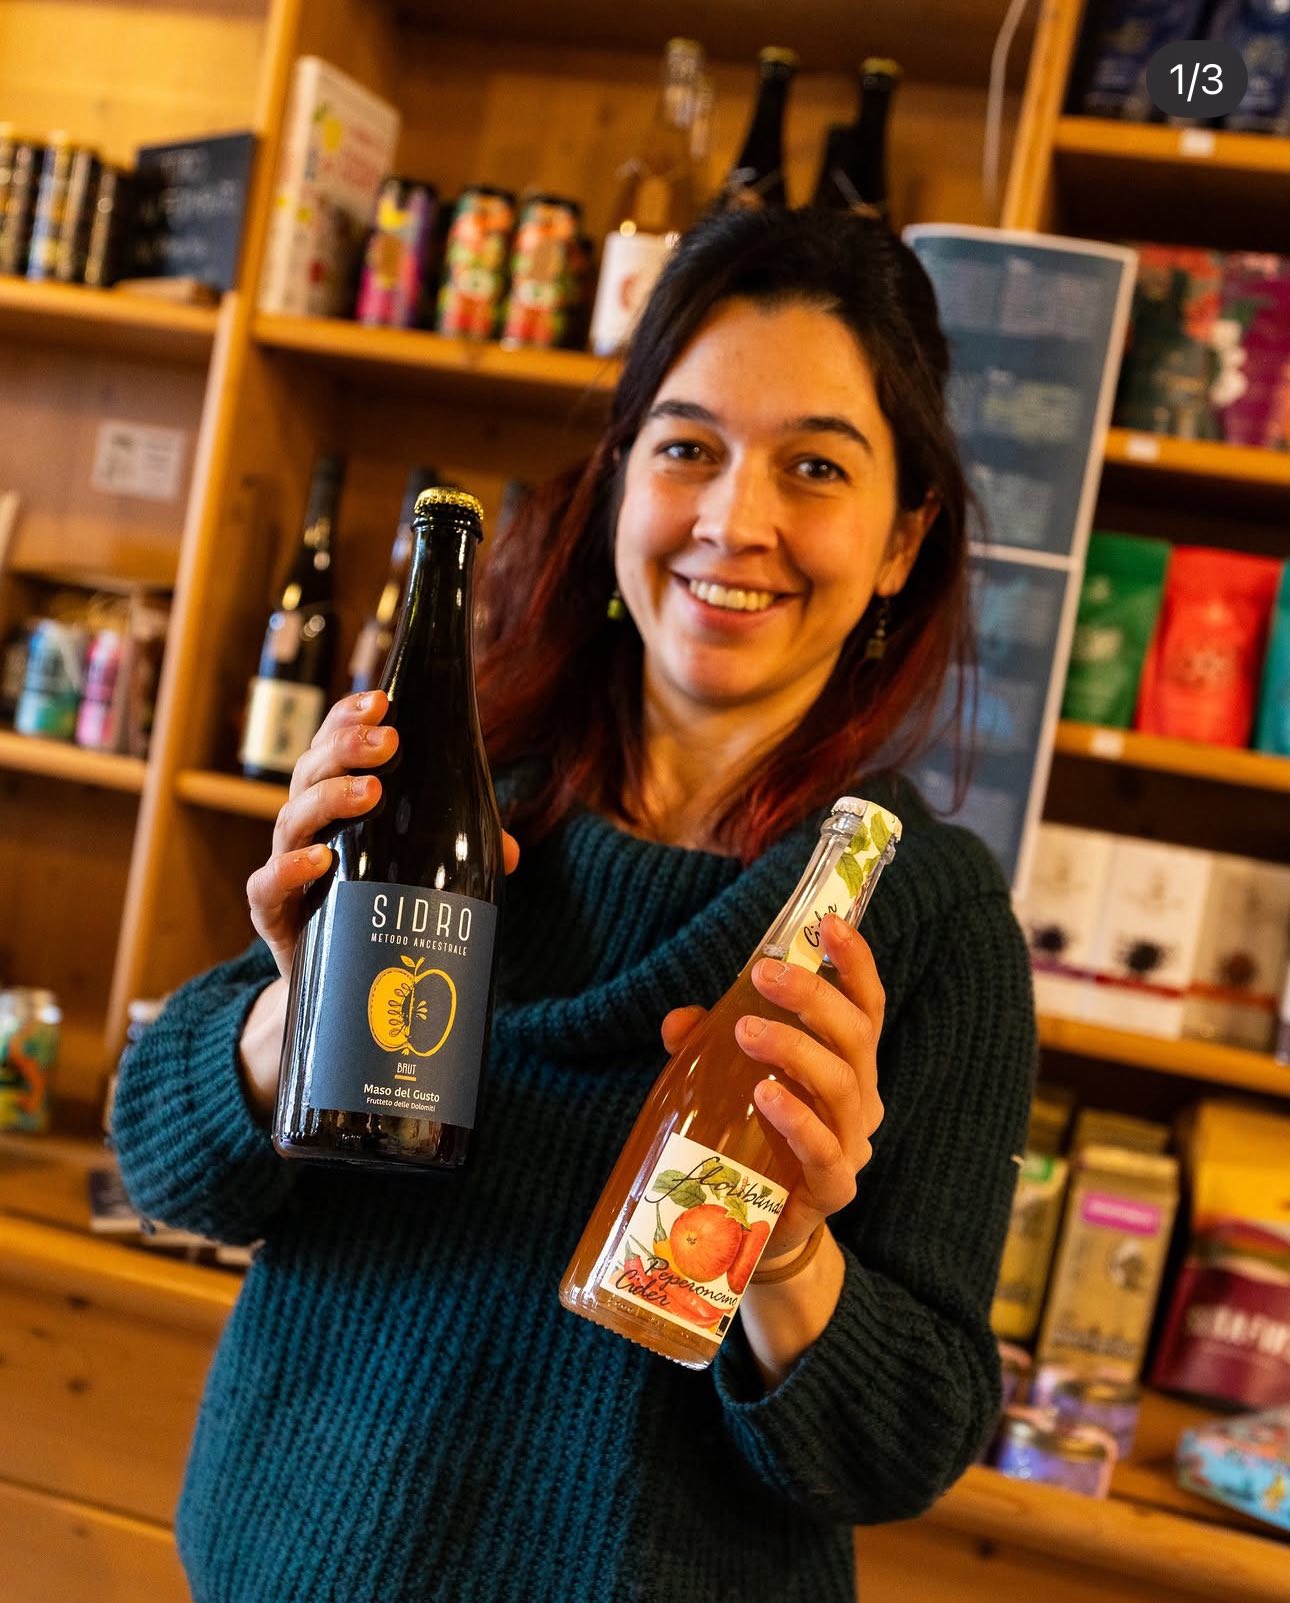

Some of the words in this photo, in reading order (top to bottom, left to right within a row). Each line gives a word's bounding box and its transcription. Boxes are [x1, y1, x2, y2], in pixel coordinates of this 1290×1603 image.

[371, 893, 473, 942] SIDRO
[370, 932, 409, 946] METODO
[413, 937, 468, 957] ANCESTRALE
[396, 1062, 417, 1075] BRUT
[363, 1083, 392, 1096] Maso
[394, 1086, 410, 1098] del
[413, 1089, 440, 1103] Gusto
[366, 1097, 393, 1107] Frutteto
[393, 1101, 410, 1109] delle
[410, 1102, 436, 1112] Dolomiti
[615, 1269, 671, 1307] Cider
[644, 1256, 739, 1307] Peperoncino
